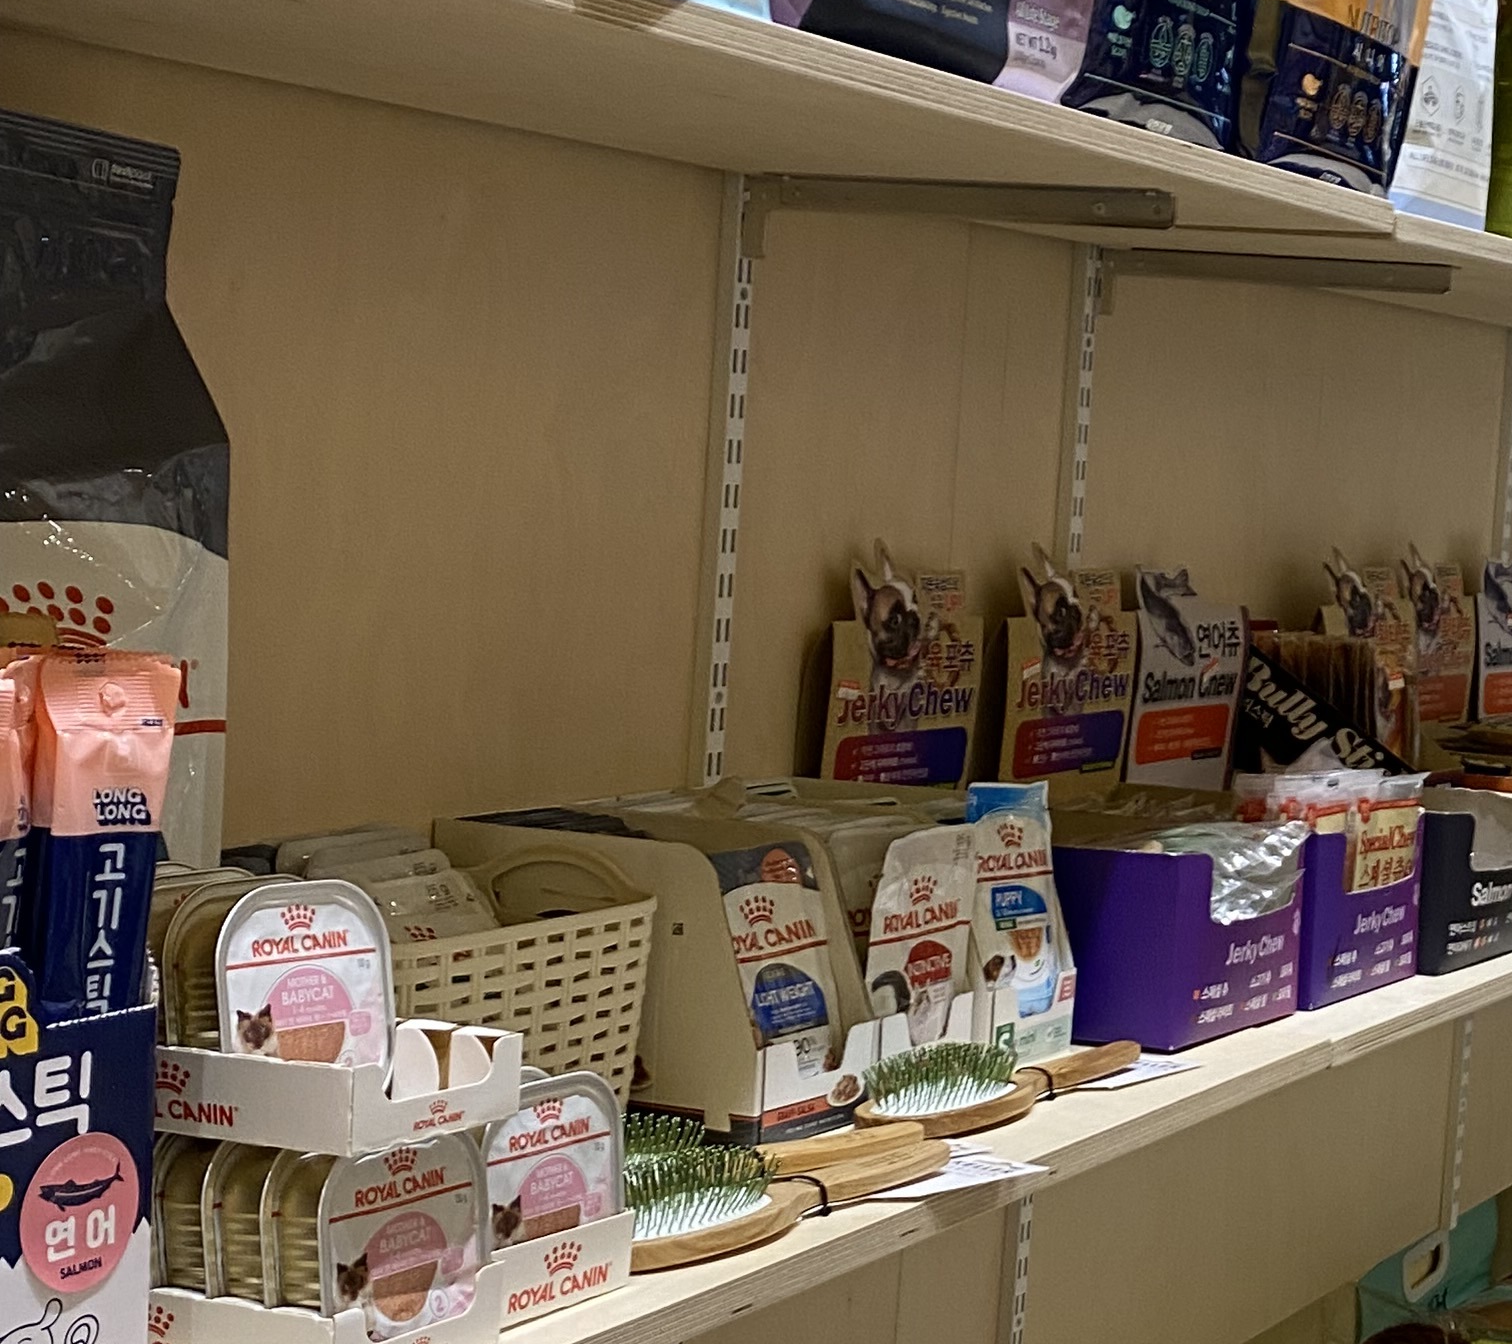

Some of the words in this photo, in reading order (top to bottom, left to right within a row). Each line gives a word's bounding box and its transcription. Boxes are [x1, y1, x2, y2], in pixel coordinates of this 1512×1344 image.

[1196, 622, 1240, 659] 연어츄
[1142, 671, 1195, 705] Salmon
[1246, 655, 1329, 742] Bully
[92, 788, 143, 806] LONG
[96, 804, 149, 823] LONG
[1471, 880, 1511, 907] Salmon
[86, 842, 126, 1014] 고기스틱
[765, 919, 815, 947] CANIN
[883, 909, 921, 935] ROYAL
[252, 936, 299, 958] ROYAL
[301, 930, 349, 952] CANIN
[287, 975, 320, 988] MOTHER
[281, 986, 335, 1006] BABYCAT
[170, 1099, 234, 1128] CANIN
[413, 1119, 436, 1132] ROYAL
[437, 1112, 462, 1127] CANIN
[508, 1128, 548, 1154] ROYAL
[549, 1117, 591, 1141] CANIN
[354, 1182, 401, 1209] ROYAL
[403, 1169, 446, 1195] CANIN
[530, 1170, 574, 1195] BABYCAT
[45, 1204, 116, 1263] 연어
[379, 1228, 432, 1254] BABYCAT
[60, 1255, 102, 1280] SALMON
[508, 1283, 556, 1315] ROYAL
[559, 1264, 610, 1298] CANIN
